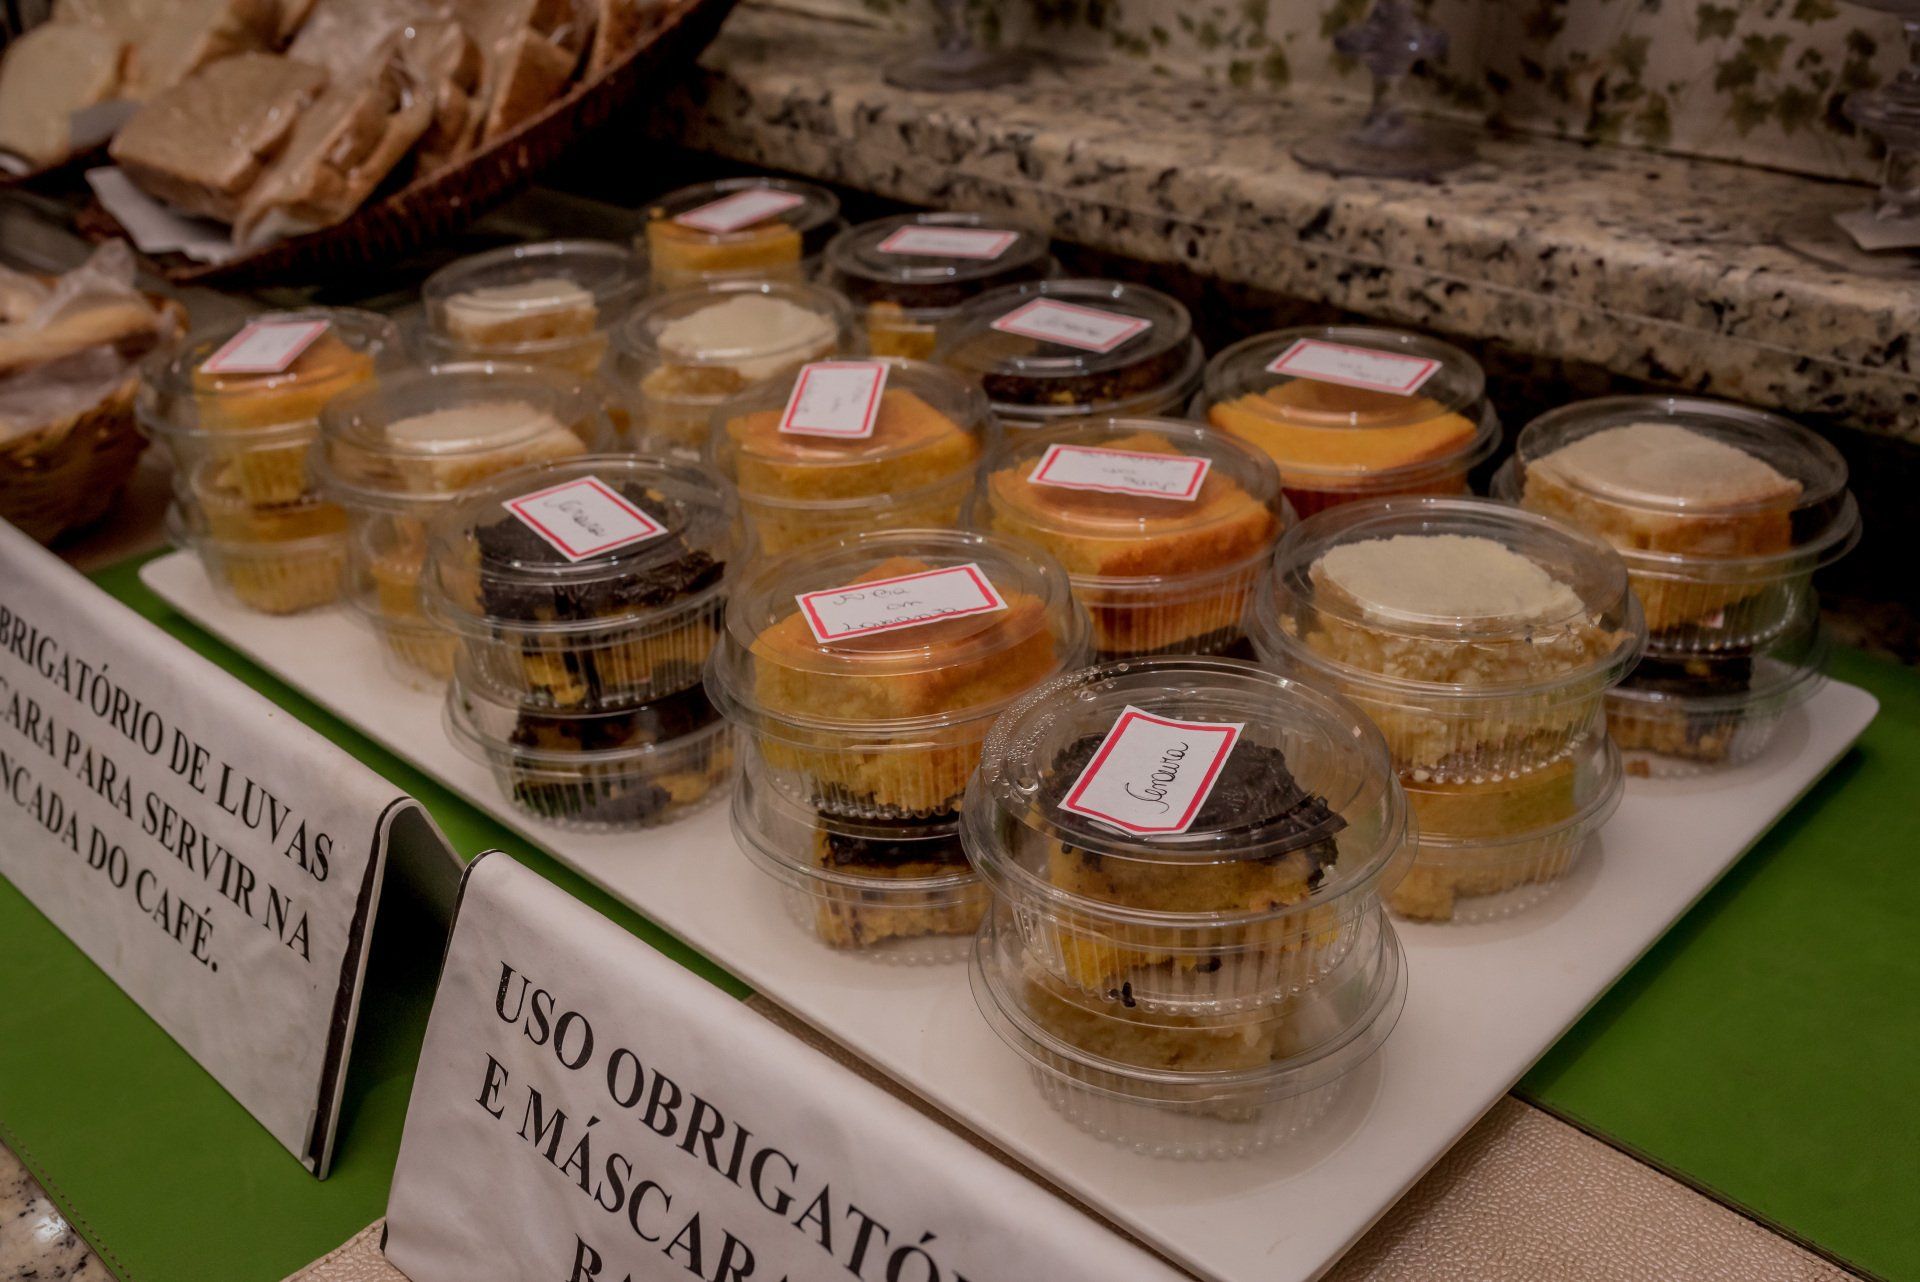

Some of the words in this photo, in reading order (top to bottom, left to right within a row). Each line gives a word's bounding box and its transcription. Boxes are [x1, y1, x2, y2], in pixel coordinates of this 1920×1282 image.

[63, 728, 133, 821] PARA
[142, 791, 254, 918] SERVIR
[263, 883, 311, 963] NA
[87, 825, 129, 889] DO
[135, 868, 218, 973] CAFÉ.
[168, 727, 211, 794] DE
[215, 761, 334, 882] LUVAS
[474, 1052, 509, 1120] E
[516, 1084, 788, 1282] MÁSCAR
[494, 961, 595, 1071] USO
[606, 1046, 974, 1282] OBRIGATÓ
